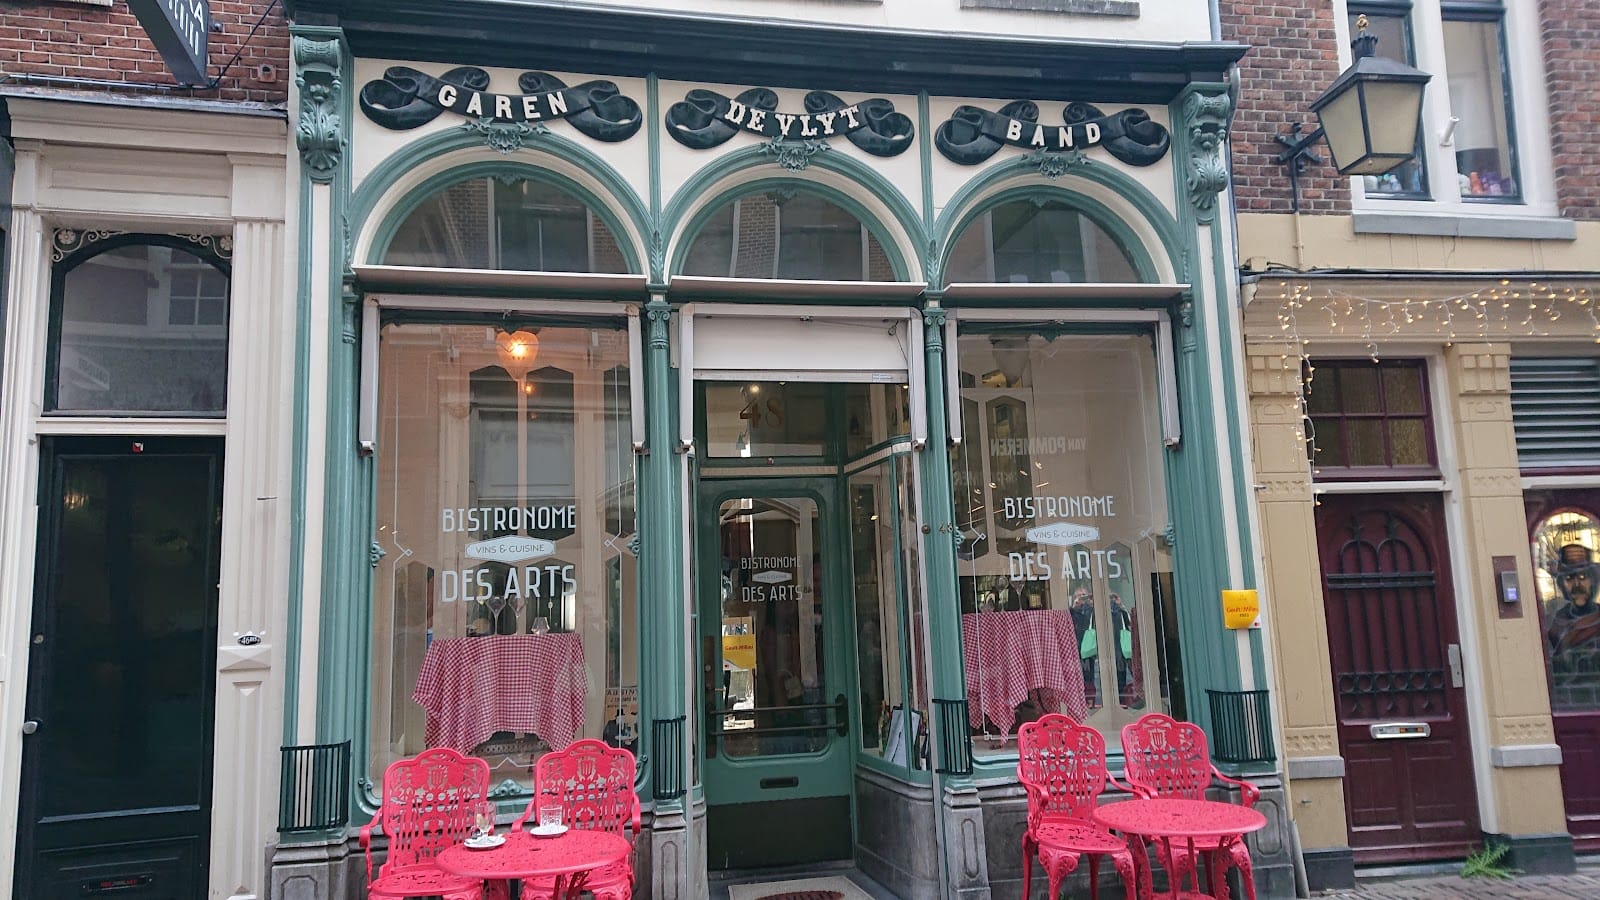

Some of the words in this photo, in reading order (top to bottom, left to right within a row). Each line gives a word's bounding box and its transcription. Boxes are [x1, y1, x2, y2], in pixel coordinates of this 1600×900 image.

[438, 84, 568, 119] GAREN
[724, 99, 766, 132] DE
[775, 105, 859, 136] VLYT
[1006, 118, 1101, 148] BAND
[739, 398, 786, 428] 48
[442, 505, 576, 532] BISTRONOME
[1004, 495, 1116, 519] BISTRONOME
[475, 546, 497, 554] VINS
[499, 545, 506, 553] &
[508, 544, 545, 553] CUISINE
[1033, 530, 1052, 539] VINS
[1061, 529, 1092, 538] CUISINE
[1009, 552, 1051, 582] DES
[1061, 550, 1122, 580] ARTS
[442, 568, 493, 603] DES
[504, 564, 577, 600] ARTS
[742, 586, 765, 603] DES
[769, 585, 803, 601] ARTS
